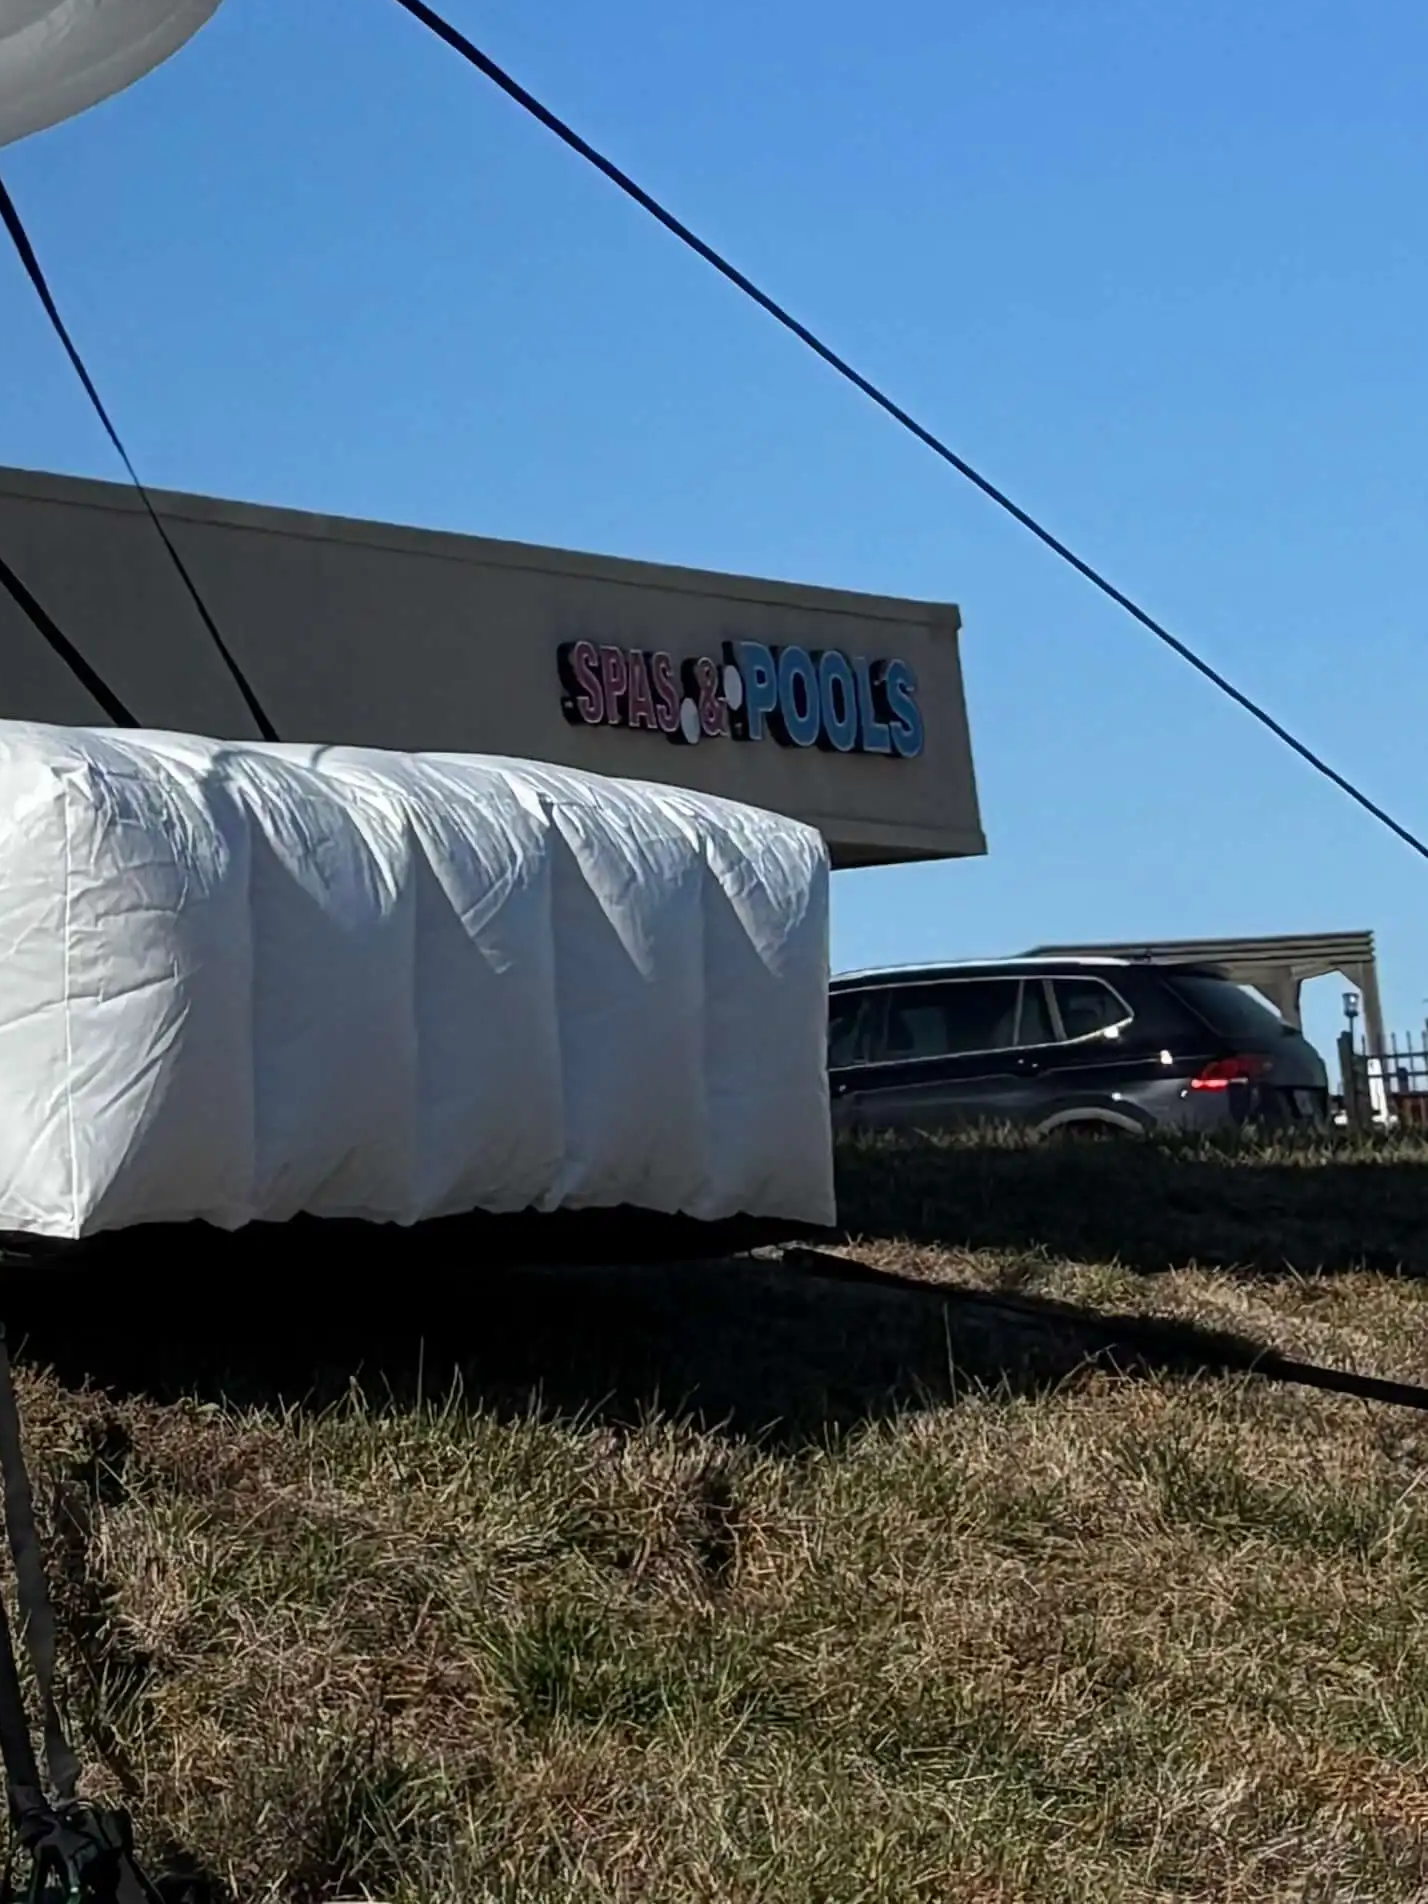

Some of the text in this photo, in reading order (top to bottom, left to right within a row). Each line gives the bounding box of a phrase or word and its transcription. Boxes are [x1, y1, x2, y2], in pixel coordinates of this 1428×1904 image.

[570, 640, 925, 758] SPAS & POOLS
